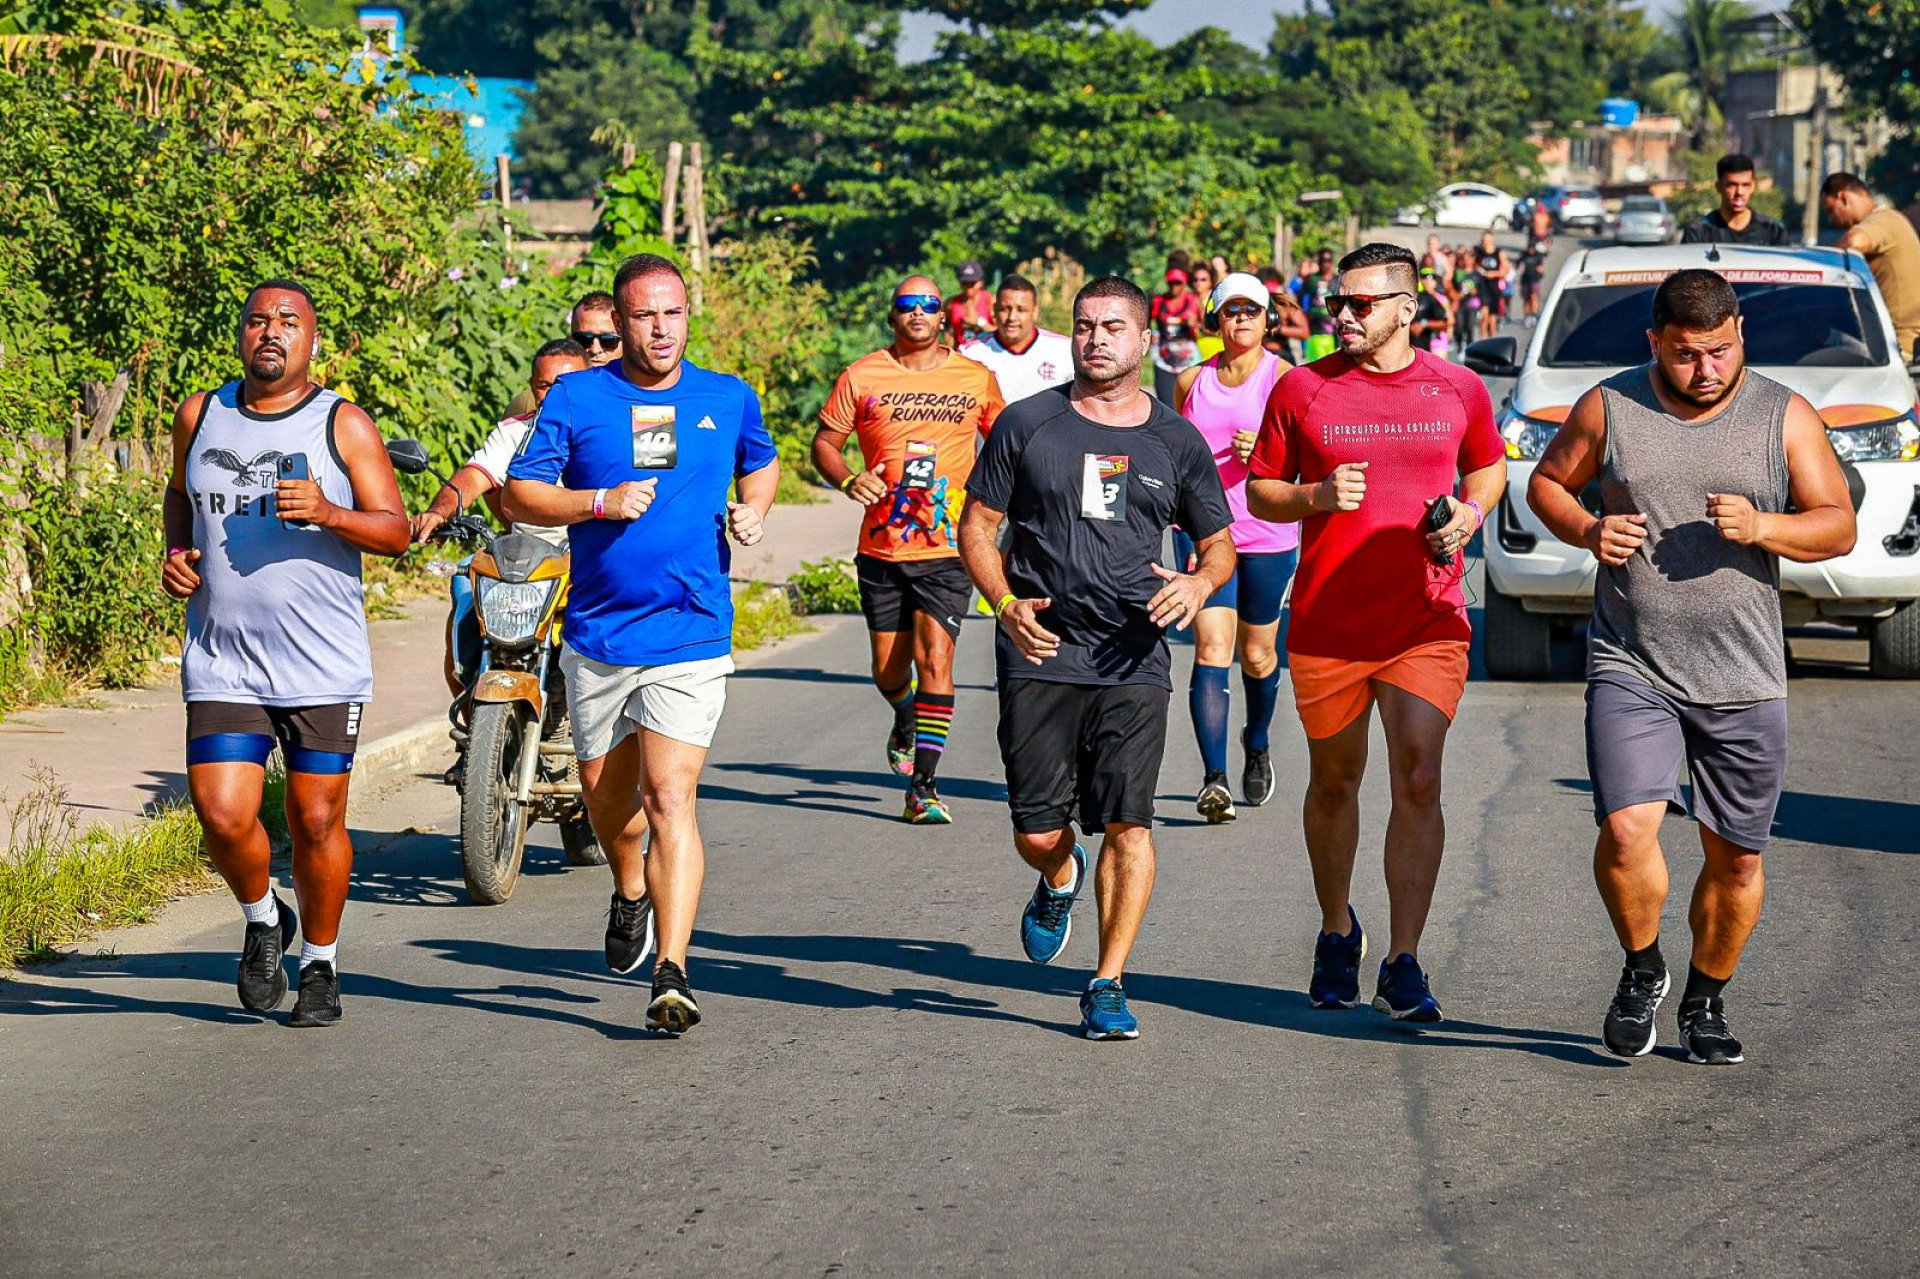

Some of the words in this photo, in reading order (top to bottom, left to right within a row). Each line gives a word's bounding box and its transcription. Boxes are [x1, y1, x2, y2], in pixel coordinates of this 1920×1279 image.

[879, 391, 977, 410] SUPERAÇÃO
[890, 407, 966, 424] RUNNING
[1334, 423, 1380, 435] CIRCUITO
[1384, 422, 1403, 434] DAS
[640, 431, 671, 453] 10
[905, 460, 934, 477] 42
